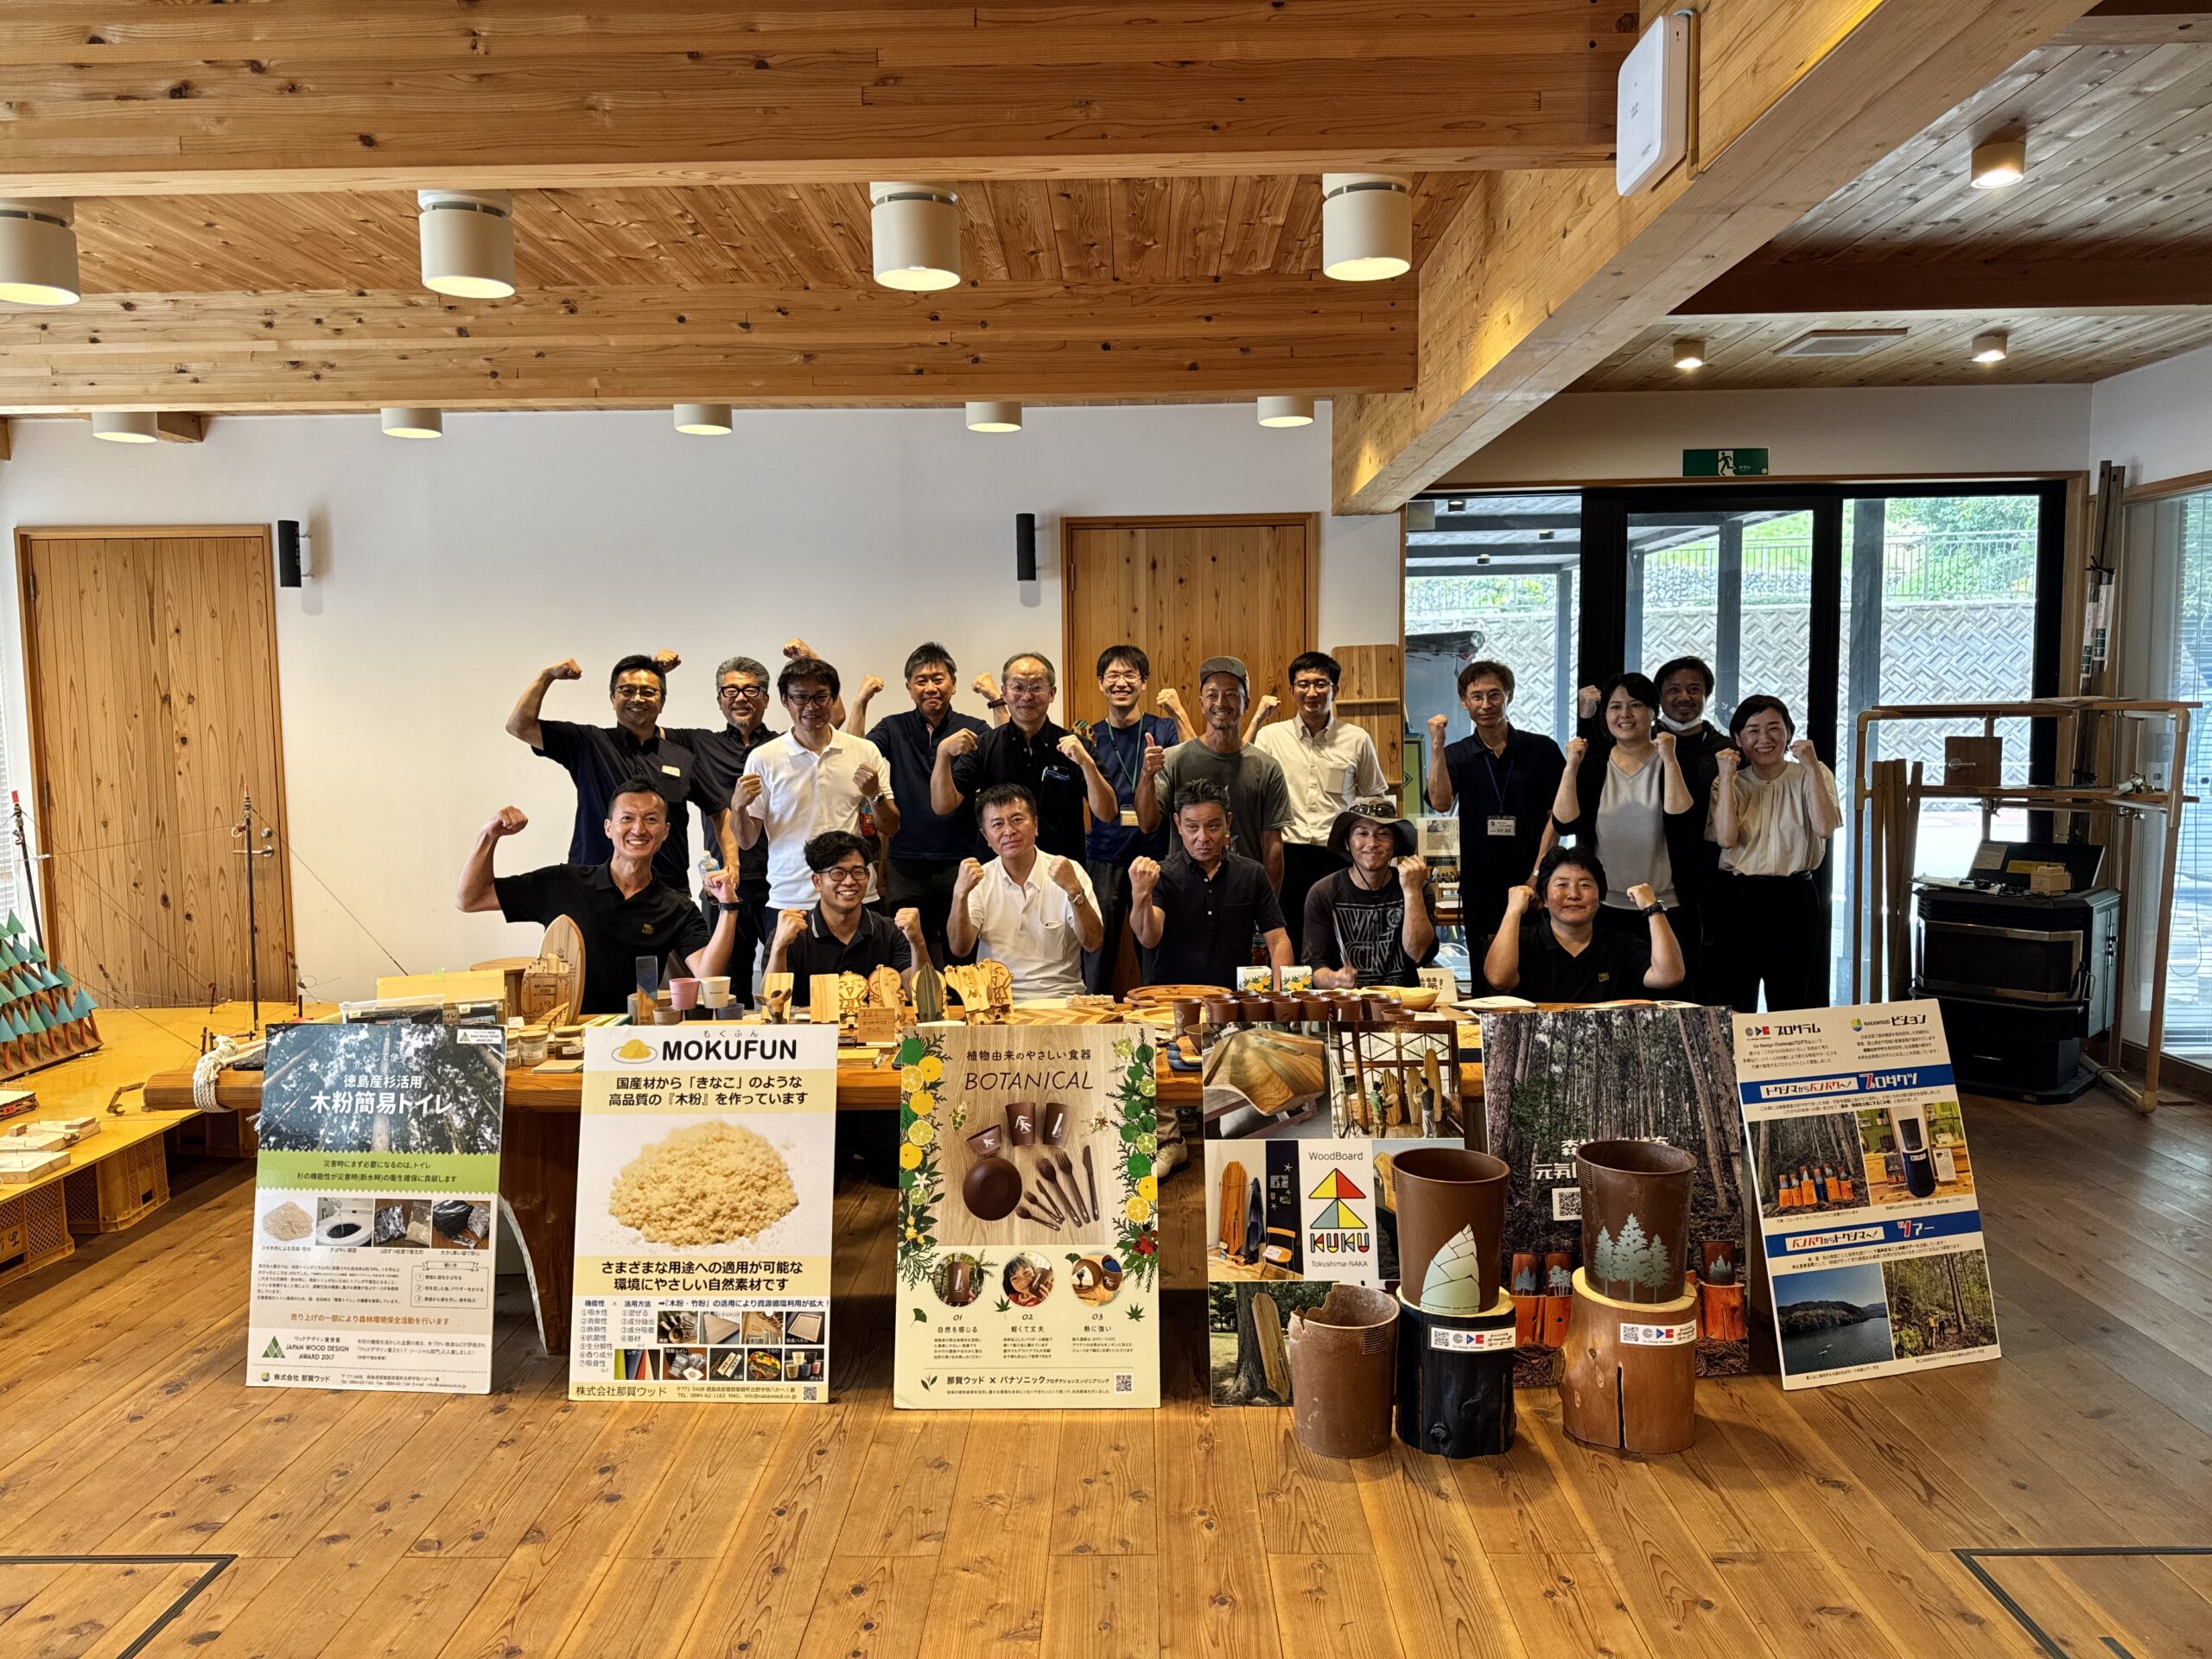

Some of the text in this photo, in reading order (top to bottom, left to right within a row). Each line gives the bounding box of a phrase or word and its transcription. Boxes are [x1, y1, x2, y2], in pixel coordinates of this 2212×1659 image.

[1891, 1014, 1926, 1027] ビジョン
[703, 1029, 759, 1038] もくふん
[1774, 1023, 1821, 1036] プログラム
[662, 1039, 798, 1061] MOKUFUN
[967, 1049, 1091, 1061] 植物由来のやさしい食器
[344, 1074, 423, 1090] 徳島産杉活用
[616, 1076, 803, 1090] 国産材から「きなこ」のような
[964, 1071, 1094, 1090] BOTANICAL
[1859, 1072, 1917, 1090] プロダクツ
[309, 1090, 453, 1116] 木粉簡易トイレ
[608, 1091, 809, 1106] 高品質の『木粉』を作っています
[1308, 1152, 1363, 1160] WoodBoard
[323, 1160, 431, 1170] 災害時にまず必要になるのは、トイレ
[1897, 1219, 1936, 1238] ツアー
[1310, 1232, 1370, 1253] KUKU
[601, 1261, 804, 1274] さまざまな用途への適用が可能な
[613, 1276, 790, 1292] 環境にやさしい自然素材です
[938, 1325, 978, 1334] 自然を感じる
[301, 1374, 331, 1382] 那賀ウッド
[946, 1376, 985, 1385] 那賀ウッド
[575, 1385, 667, 1397] 株式会社那賀ウッド
